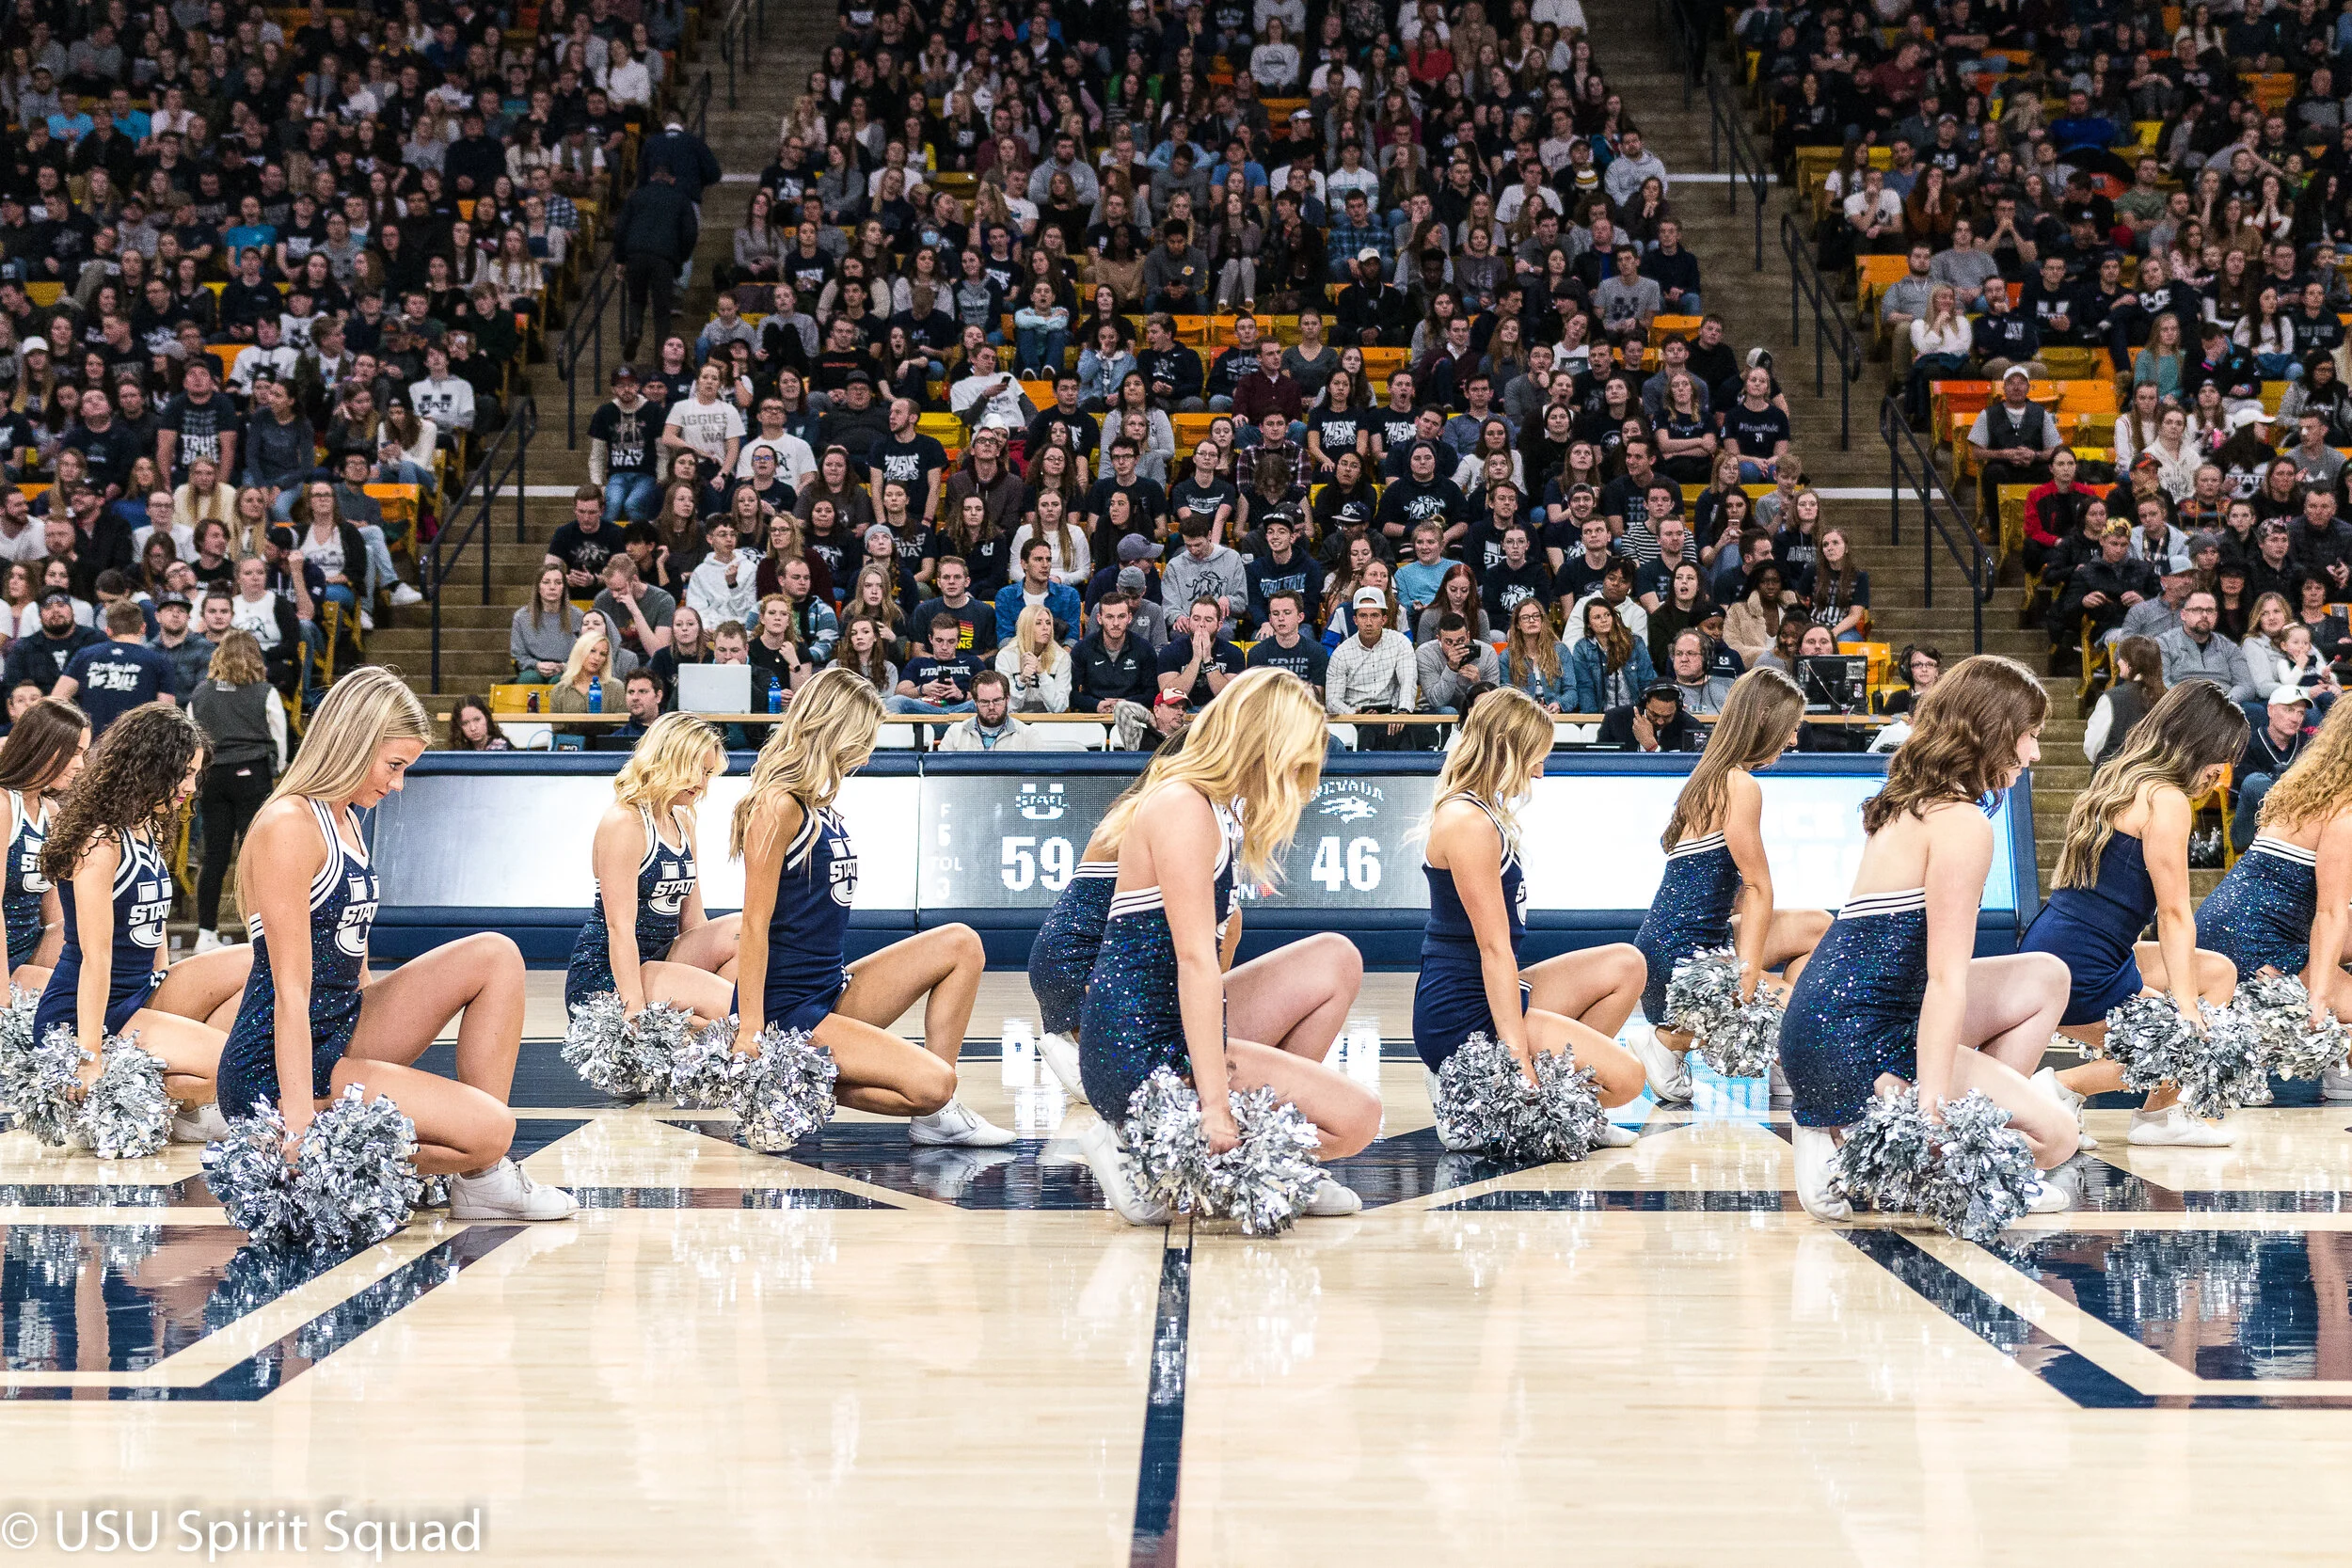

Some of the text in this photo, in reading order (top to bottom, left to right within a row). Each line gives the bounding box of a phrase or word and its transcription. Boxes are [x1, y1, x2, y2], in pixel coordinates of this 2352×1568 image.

[182, 436, 218, 451] TRUE
[612, 455, 644, 467] WAY
[1001, 835, 1074, 892] 59
[1311, 836, 1381, 892] 46
